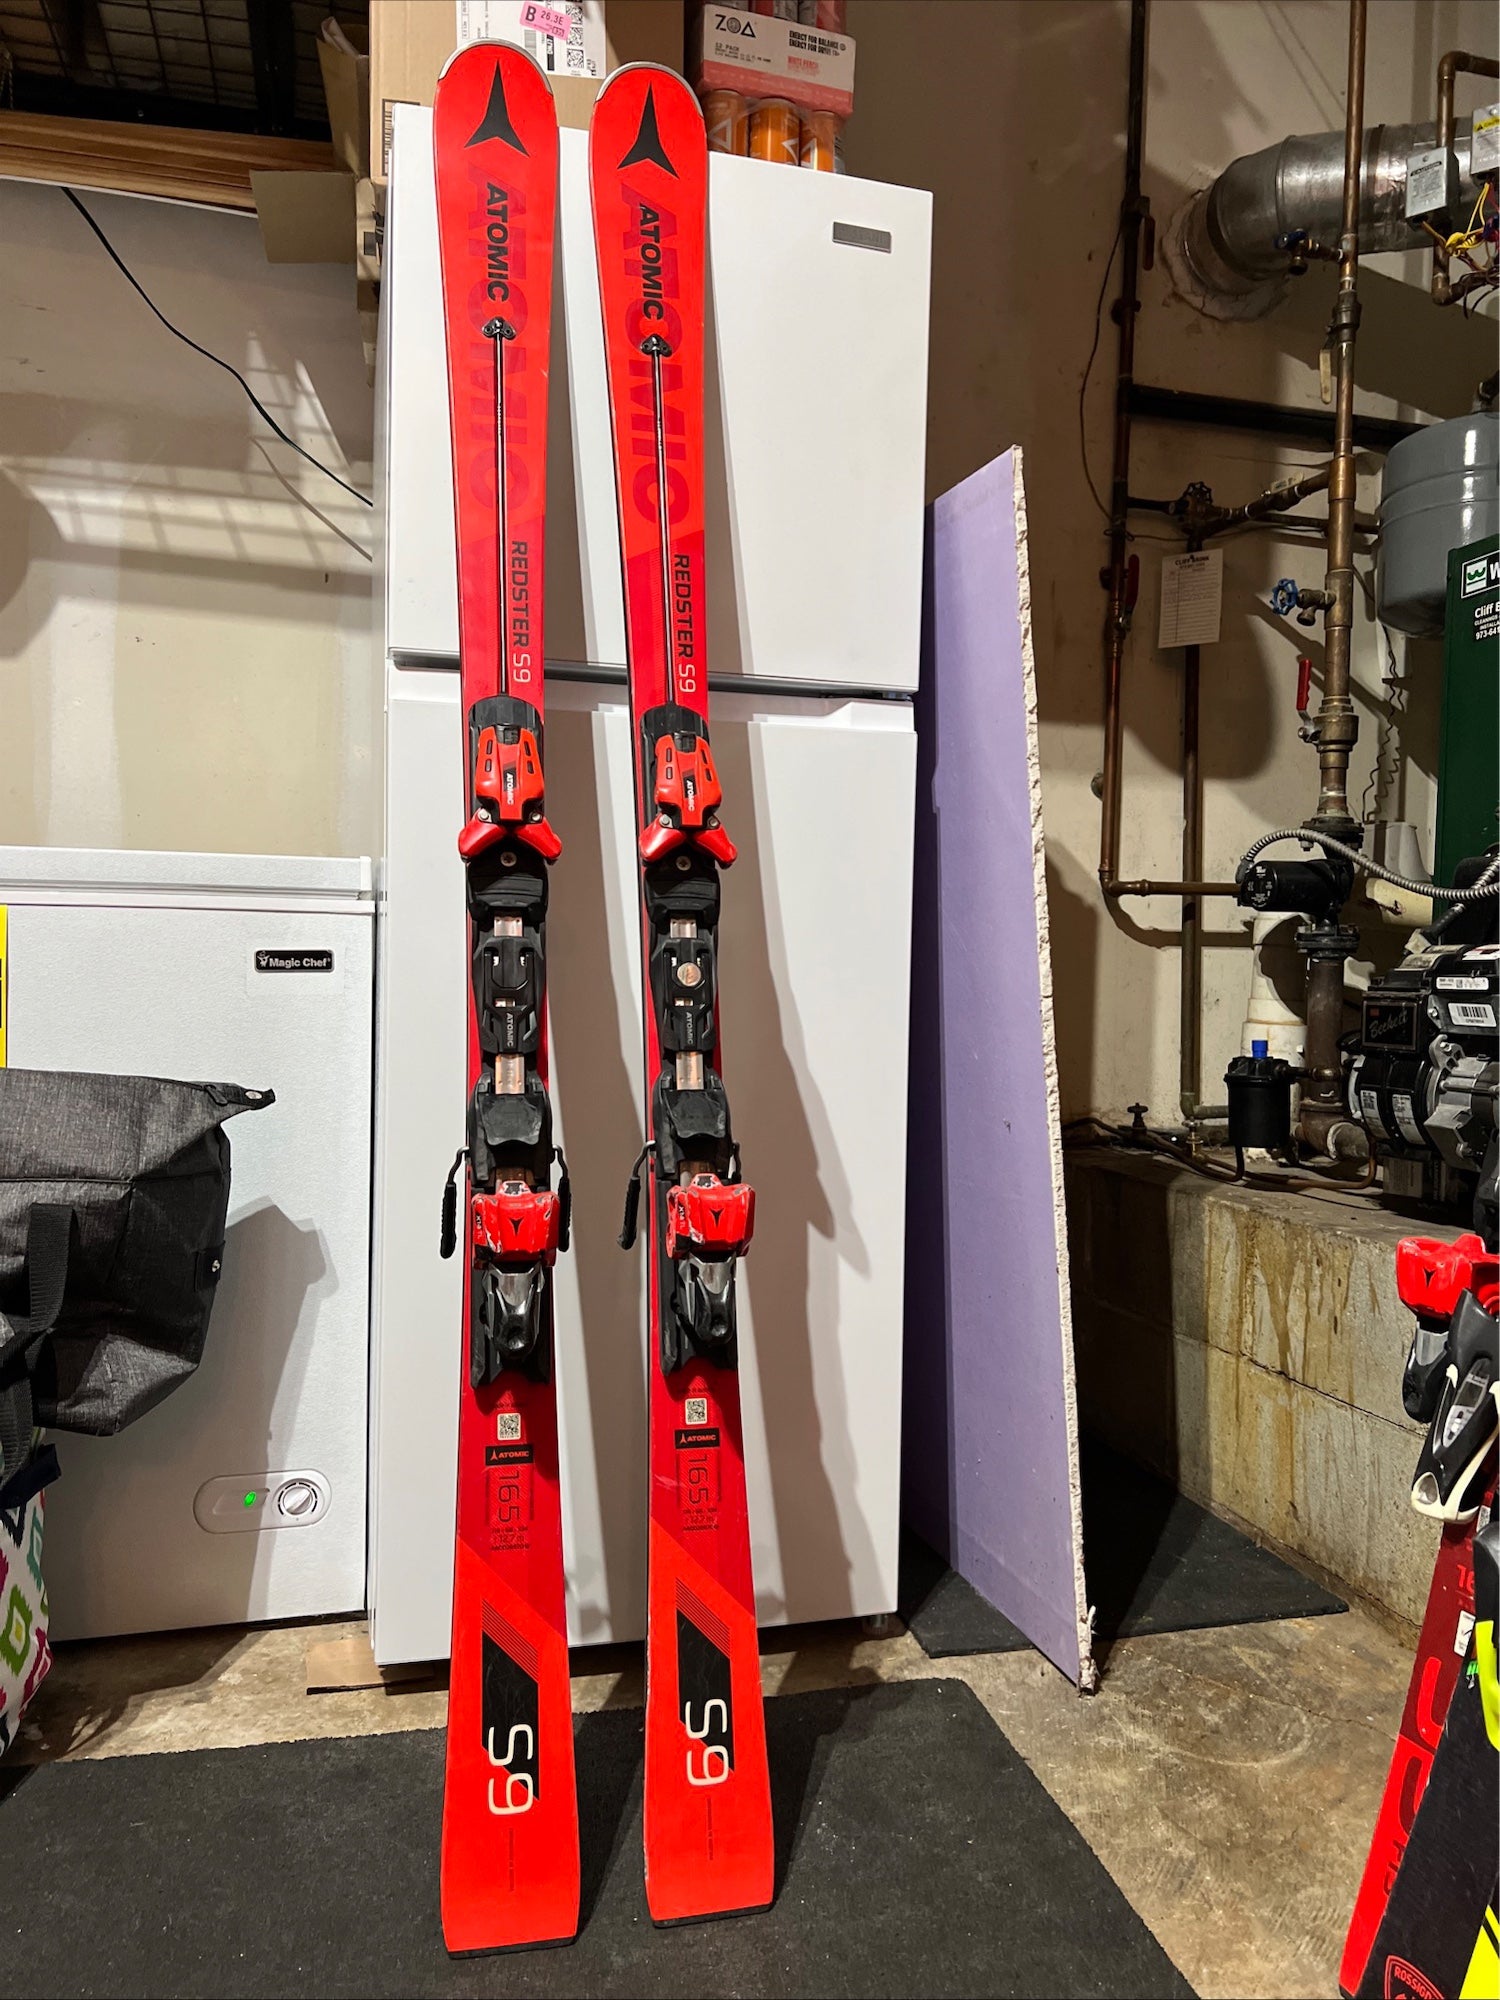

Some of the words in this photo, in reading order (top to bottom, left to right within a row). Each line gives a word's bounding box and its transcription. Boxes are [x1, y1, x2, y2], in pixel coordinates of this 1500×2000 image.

[525, 5, 537, 22] B
[714, 13, 757, 39] ZOA
[486, 181, 510, 303] ATOMIC
[639, 202, 664, 321] ATOMIC
[511, 540, 530, 648] REDSTER
[673, 553, 695, 659] REDSTER
[512, 653, 531, 684] S9
[678, 662, 697, 693] S9
[269, 957, 301, 969] Magic
[506, 1012, 514, 1048] ATOMIC
[685, 1011, 694, 1045] ATOMIC
[498, 1450, 530, 1459] ATOMIC
[686, 1434, 717, 1443] ATOMIC
[498, 1470, 521, 1523] 165
[688, 1453, 709, 1505] 165
[685, 1698, 729, 1787] S9
[488, 1723, 534, 1817] S9
